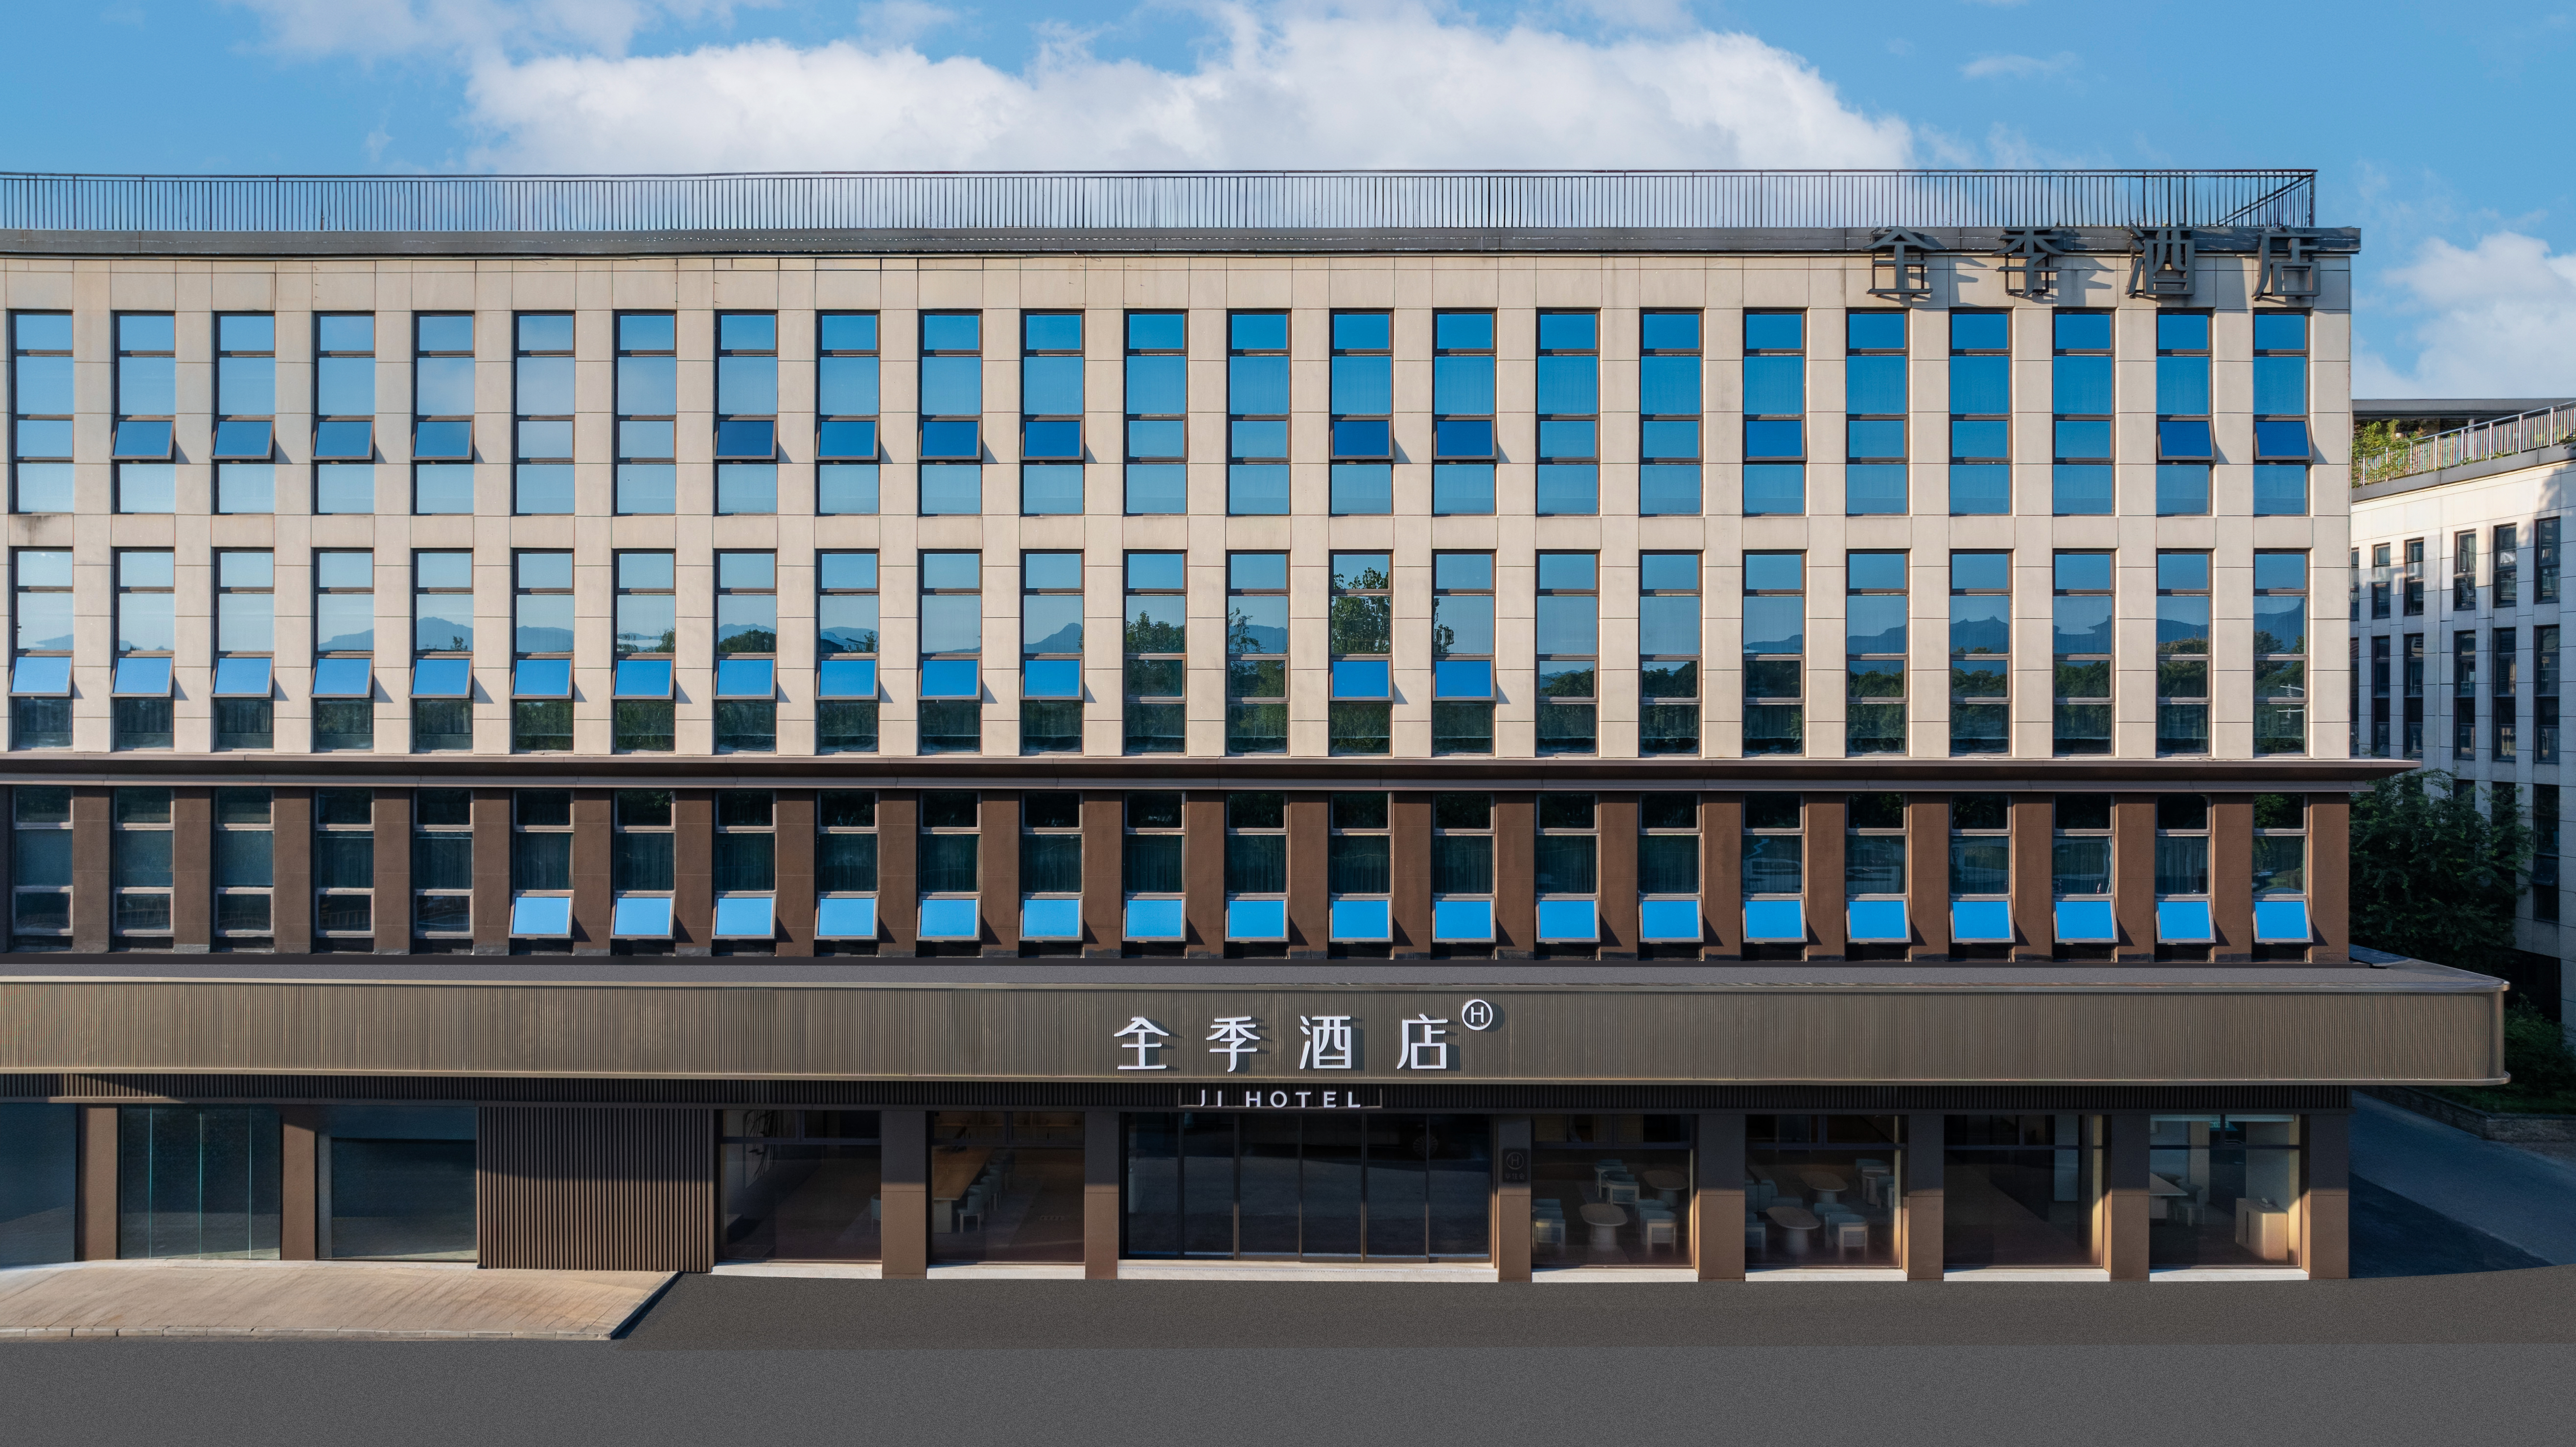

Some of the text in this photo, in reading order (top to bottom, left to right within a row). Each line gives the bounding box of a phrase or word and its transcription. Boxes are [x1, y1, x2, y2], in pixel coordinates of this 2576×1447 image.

[1863, 224, 2321, 297] 全季酒店
[1114, 1013, 1448, 1072] 全季酒店
[1200, 1090, 1361, 1108] JI HOTEL
